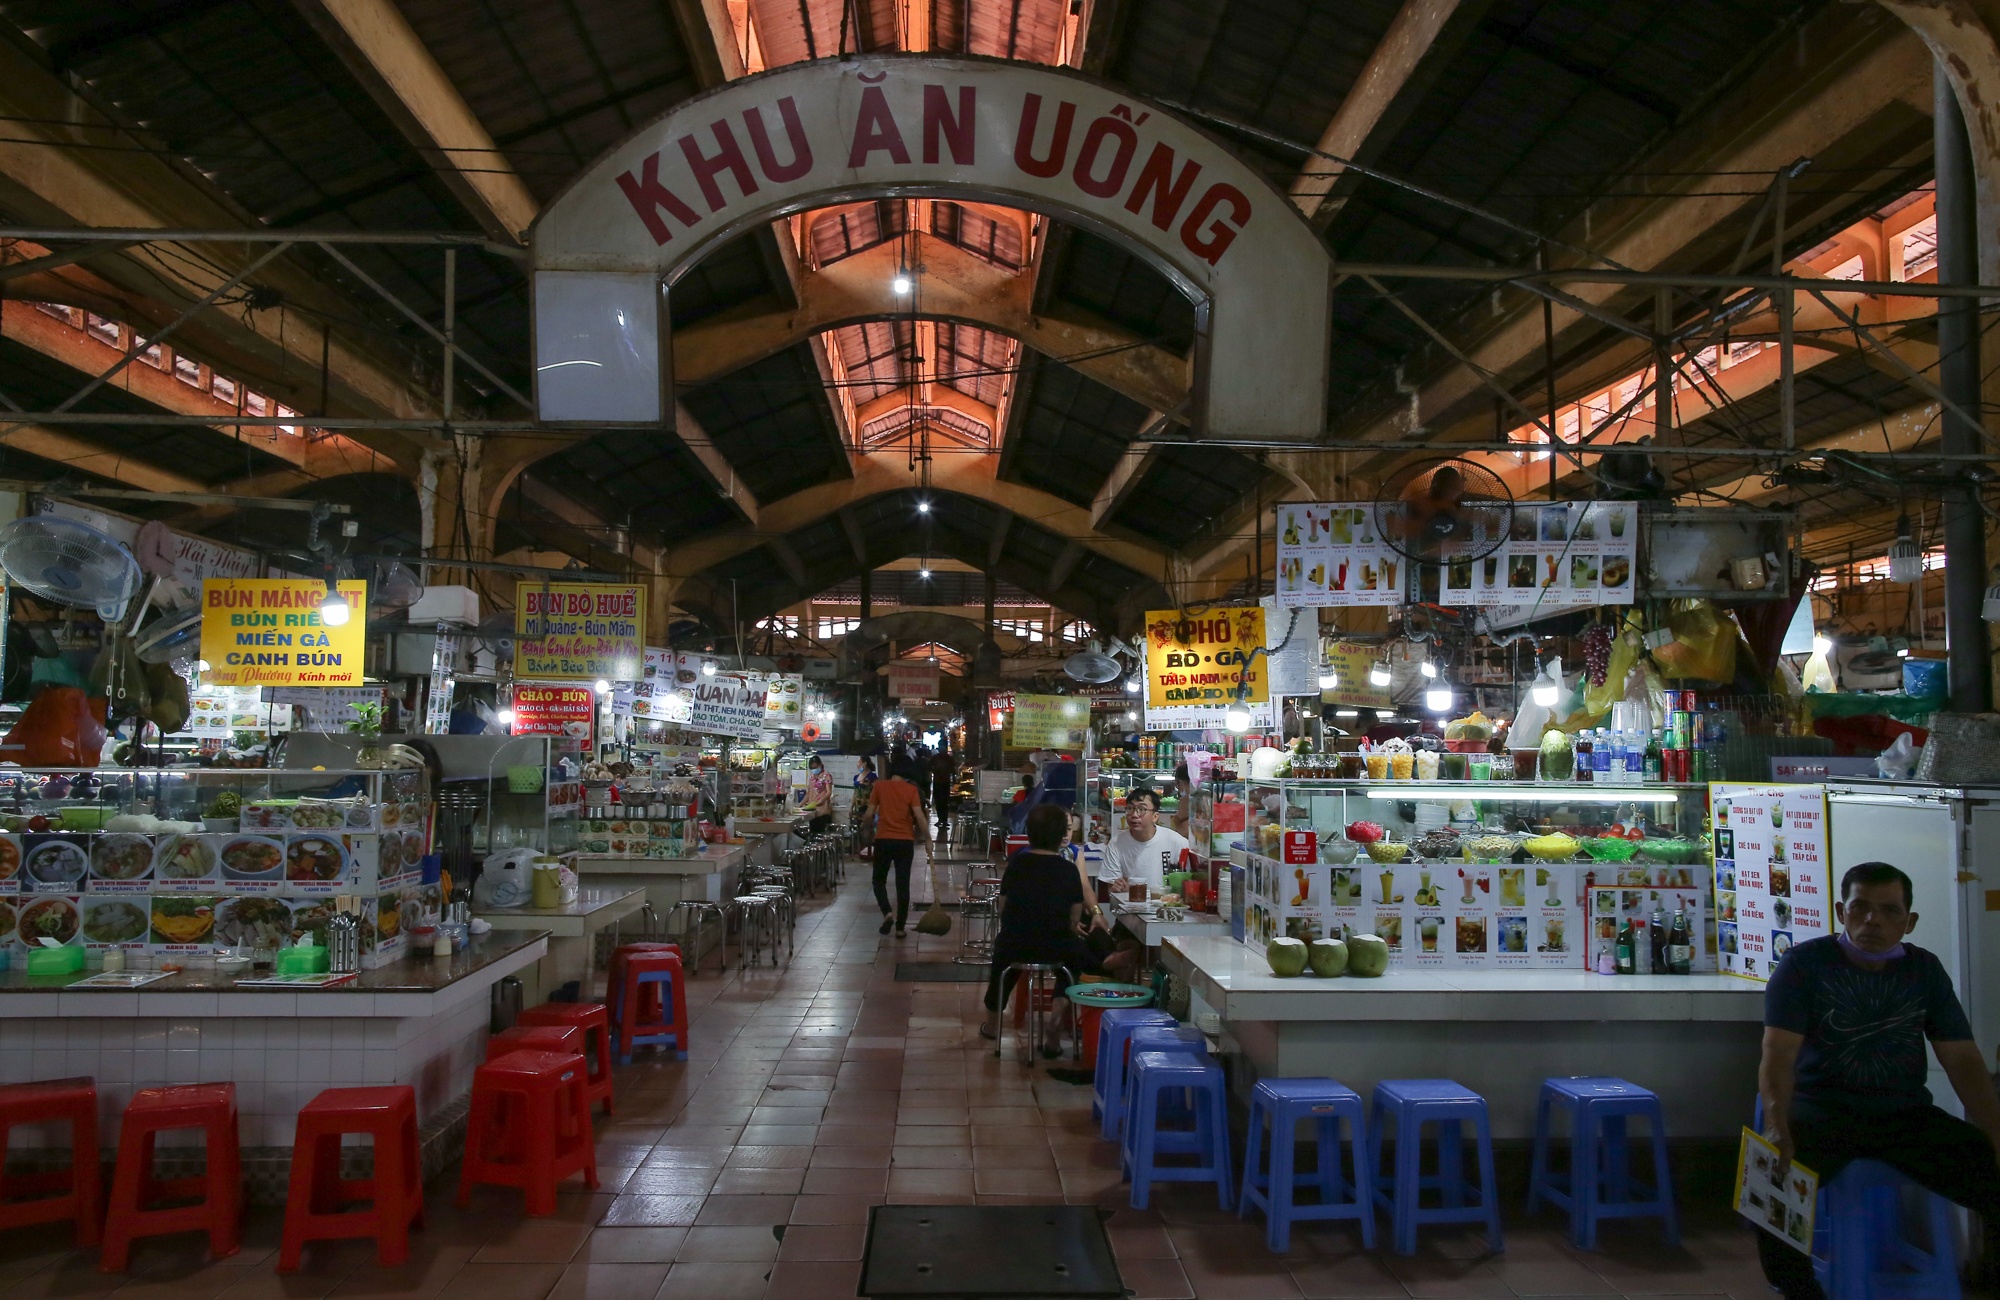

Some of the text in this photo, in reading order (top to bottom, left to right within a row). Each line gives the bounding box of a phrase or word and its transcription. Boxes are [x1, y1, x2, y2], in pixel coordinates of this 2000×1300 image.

[615, 72, 1252, 266] KHU ĂN UỐNG
[209, 586, 253, 608] BÚN
[568, 589, 593, 615] BÒ
[596, 589, 637, 616] HUẾ
[231, 610, 327, 626] BÚN RIÊ
[585, 619, 606, 635] Bún
[1182, 612, 1231, 644] PHỞ
[237, 628, 330, 646] MIẾN GÀ
[226, 650, 342, 666] CANH BÚN
[1166, 649, 1200, 667] BÒ
[298, 672, 325, 681] Kính
[329, 673, 352, 681] mời
[519, 689, 587, 702] CHÁO BÚN
[1777, 766, 1797, 776] SẠP
